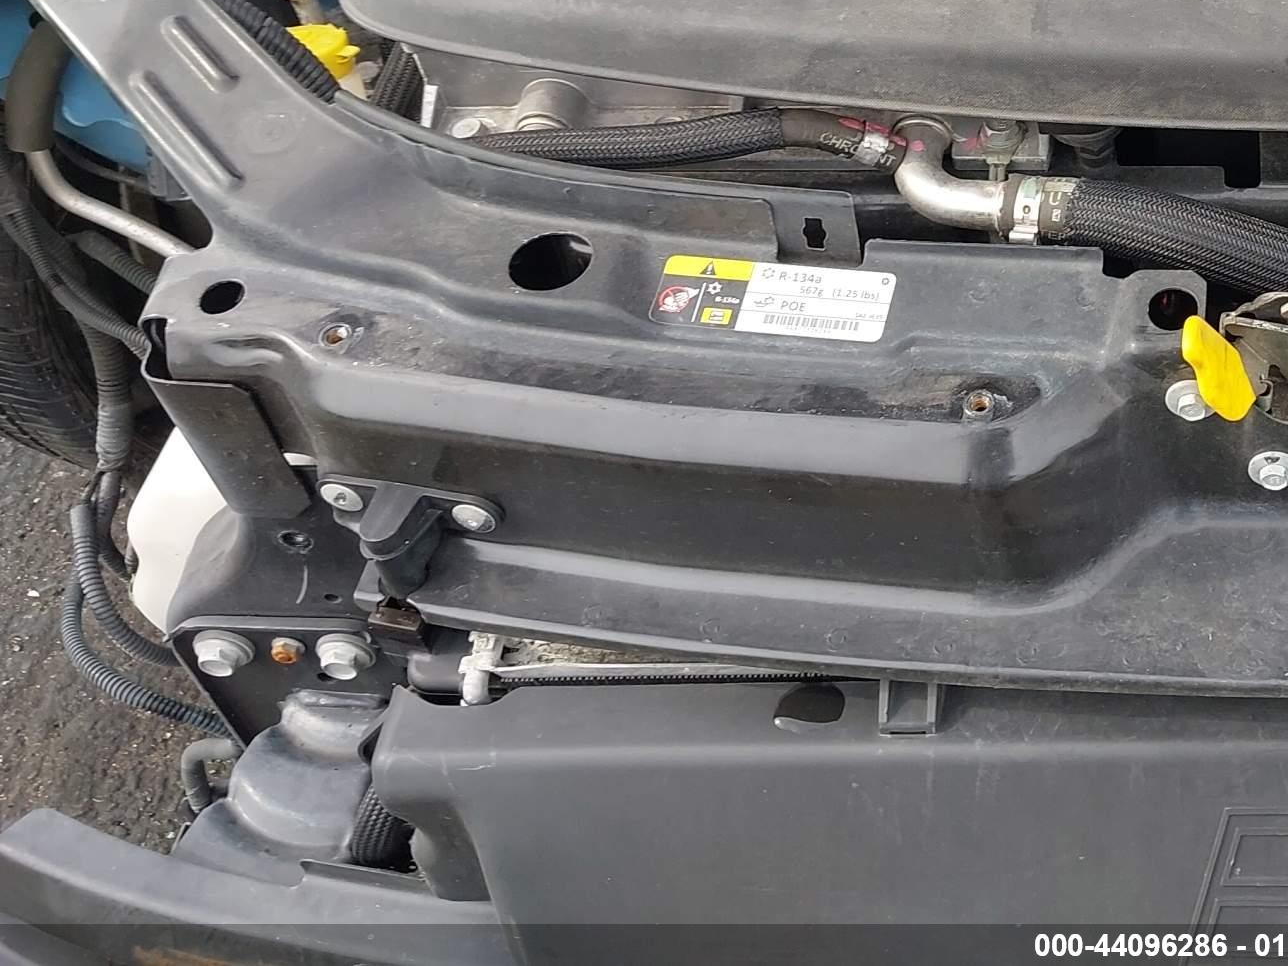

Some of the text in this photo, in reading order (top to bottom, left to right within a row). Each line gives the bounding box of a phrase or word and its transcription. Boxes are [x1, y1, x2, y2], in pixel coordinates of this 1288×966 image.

[779, 272, 822, 284] R-134a
[800, 286, 824, 297] 567g
[860, 289, 880, 301] lbs)
[780, 300, 806, 312] POE
